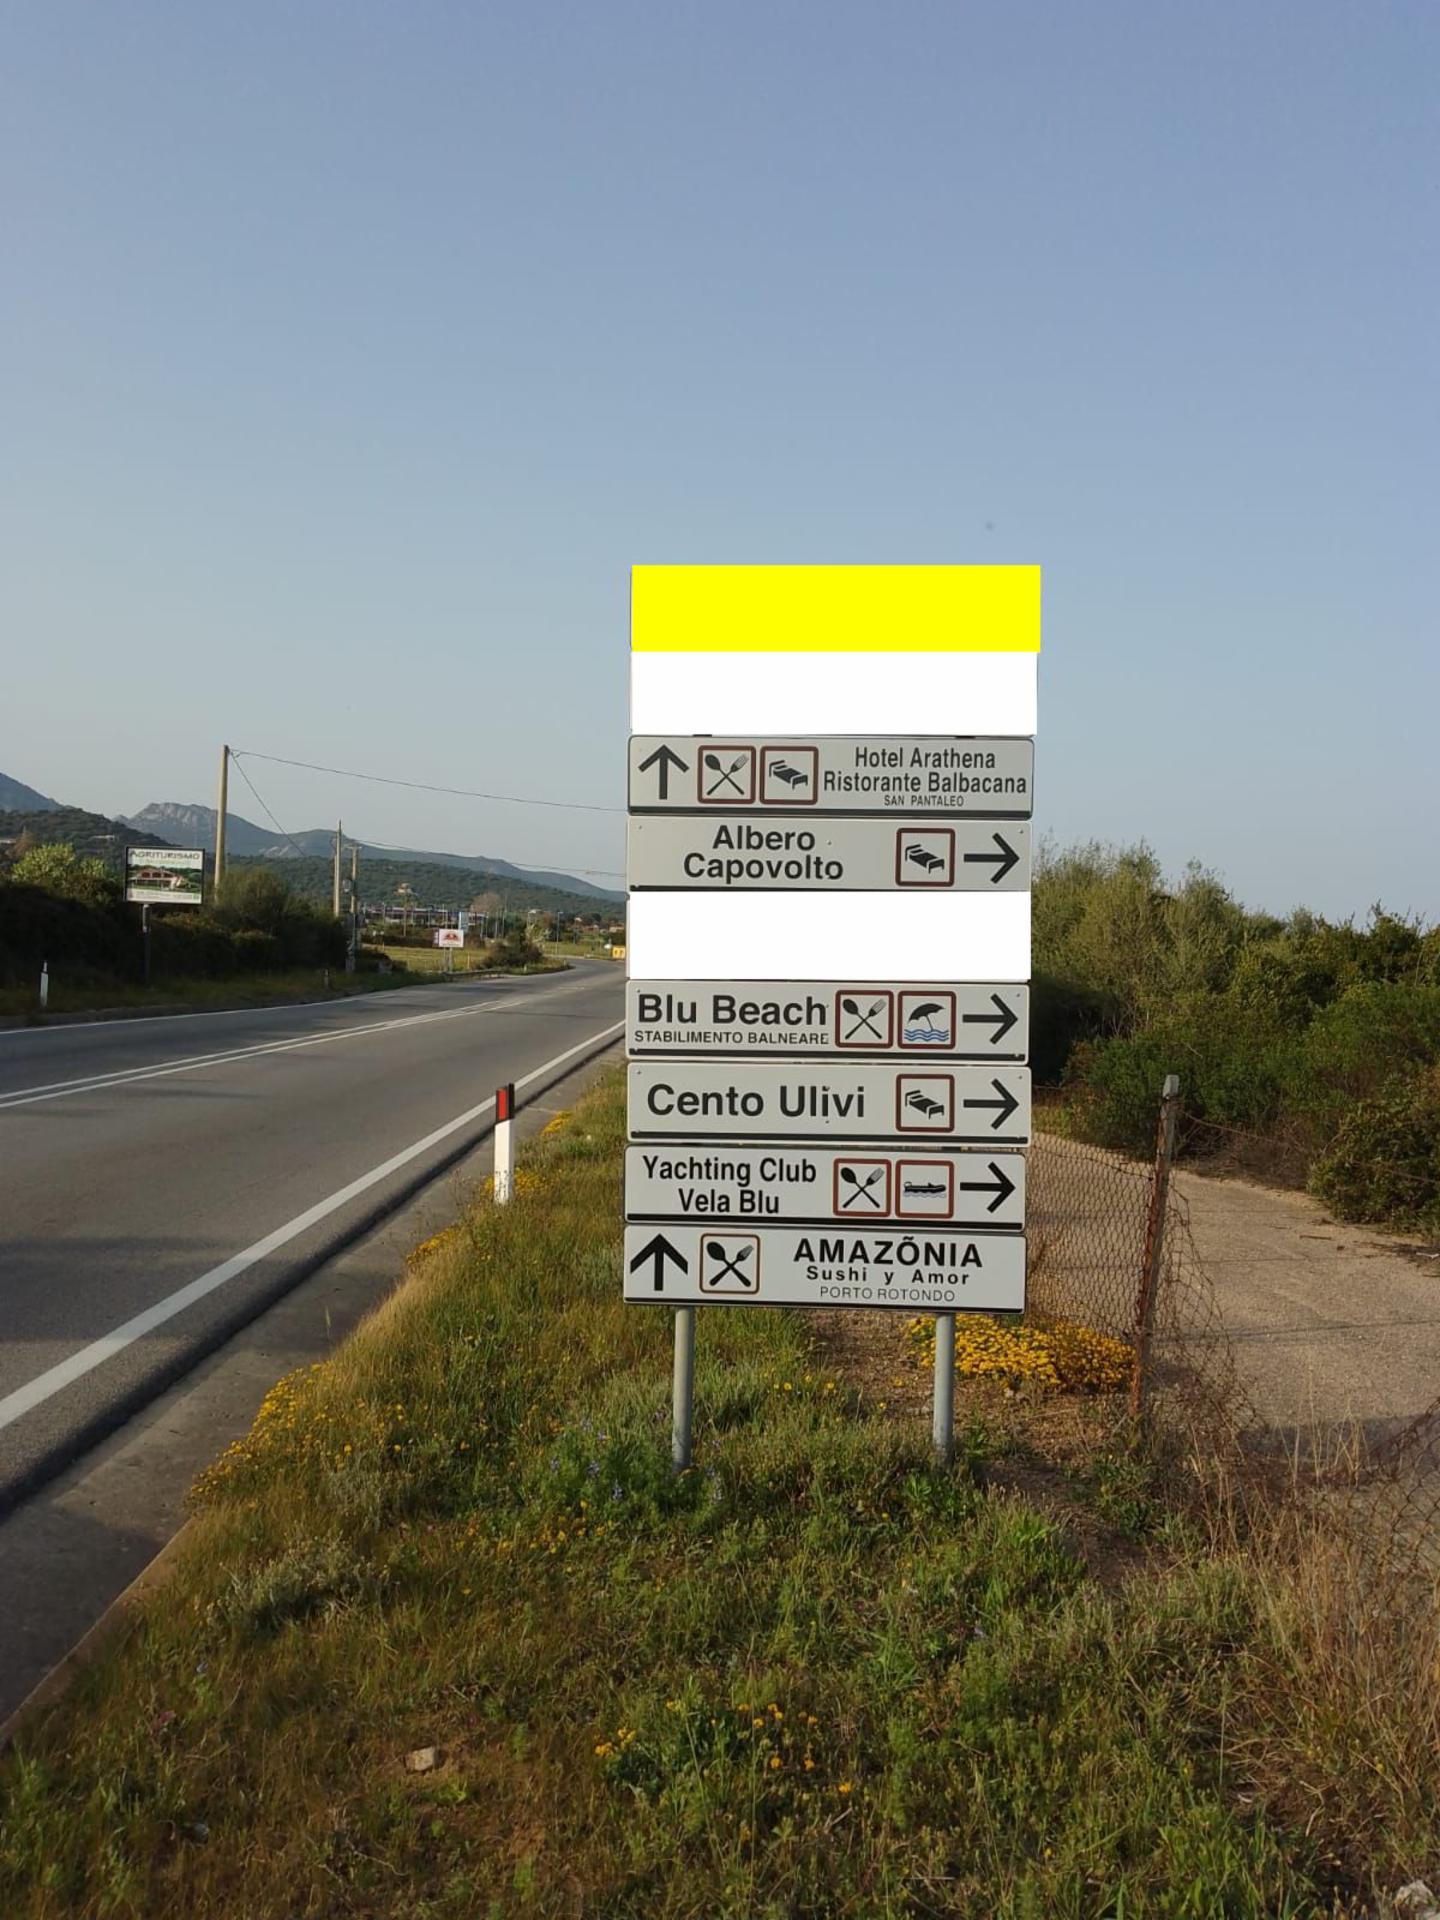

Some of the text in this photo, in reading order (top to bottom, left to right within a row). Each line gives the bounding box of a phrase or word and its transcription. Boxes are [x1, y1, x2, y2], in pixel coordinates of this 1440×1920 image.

[855, 747, 995, 769] Hotel Arathena
[824, 771, 1027, 794] Ristorante Balbacana
[884, 794, 964, 807] SAN PANTALEO
[713, 825, 815, 851] Albero
[684, 852, 844, 884] Capovolto
[638, 994, 828, 1026] Blu Beach
[634, 1030, 829, 1045] STABILIMENTO BALNEARE
[647, 1084, 865, 1118] Cento Ulivi
[642, 1155, 817, 1187] Yachting Club
[678, 1189, 780, 1214] Vela Blu
[793, 1236, 983, 1267] AMAZÕNIA
[806, 1265, 969, 1285] Sushi y Amor
[820, 1287, 955, 1302] PORTO ROTONDO
